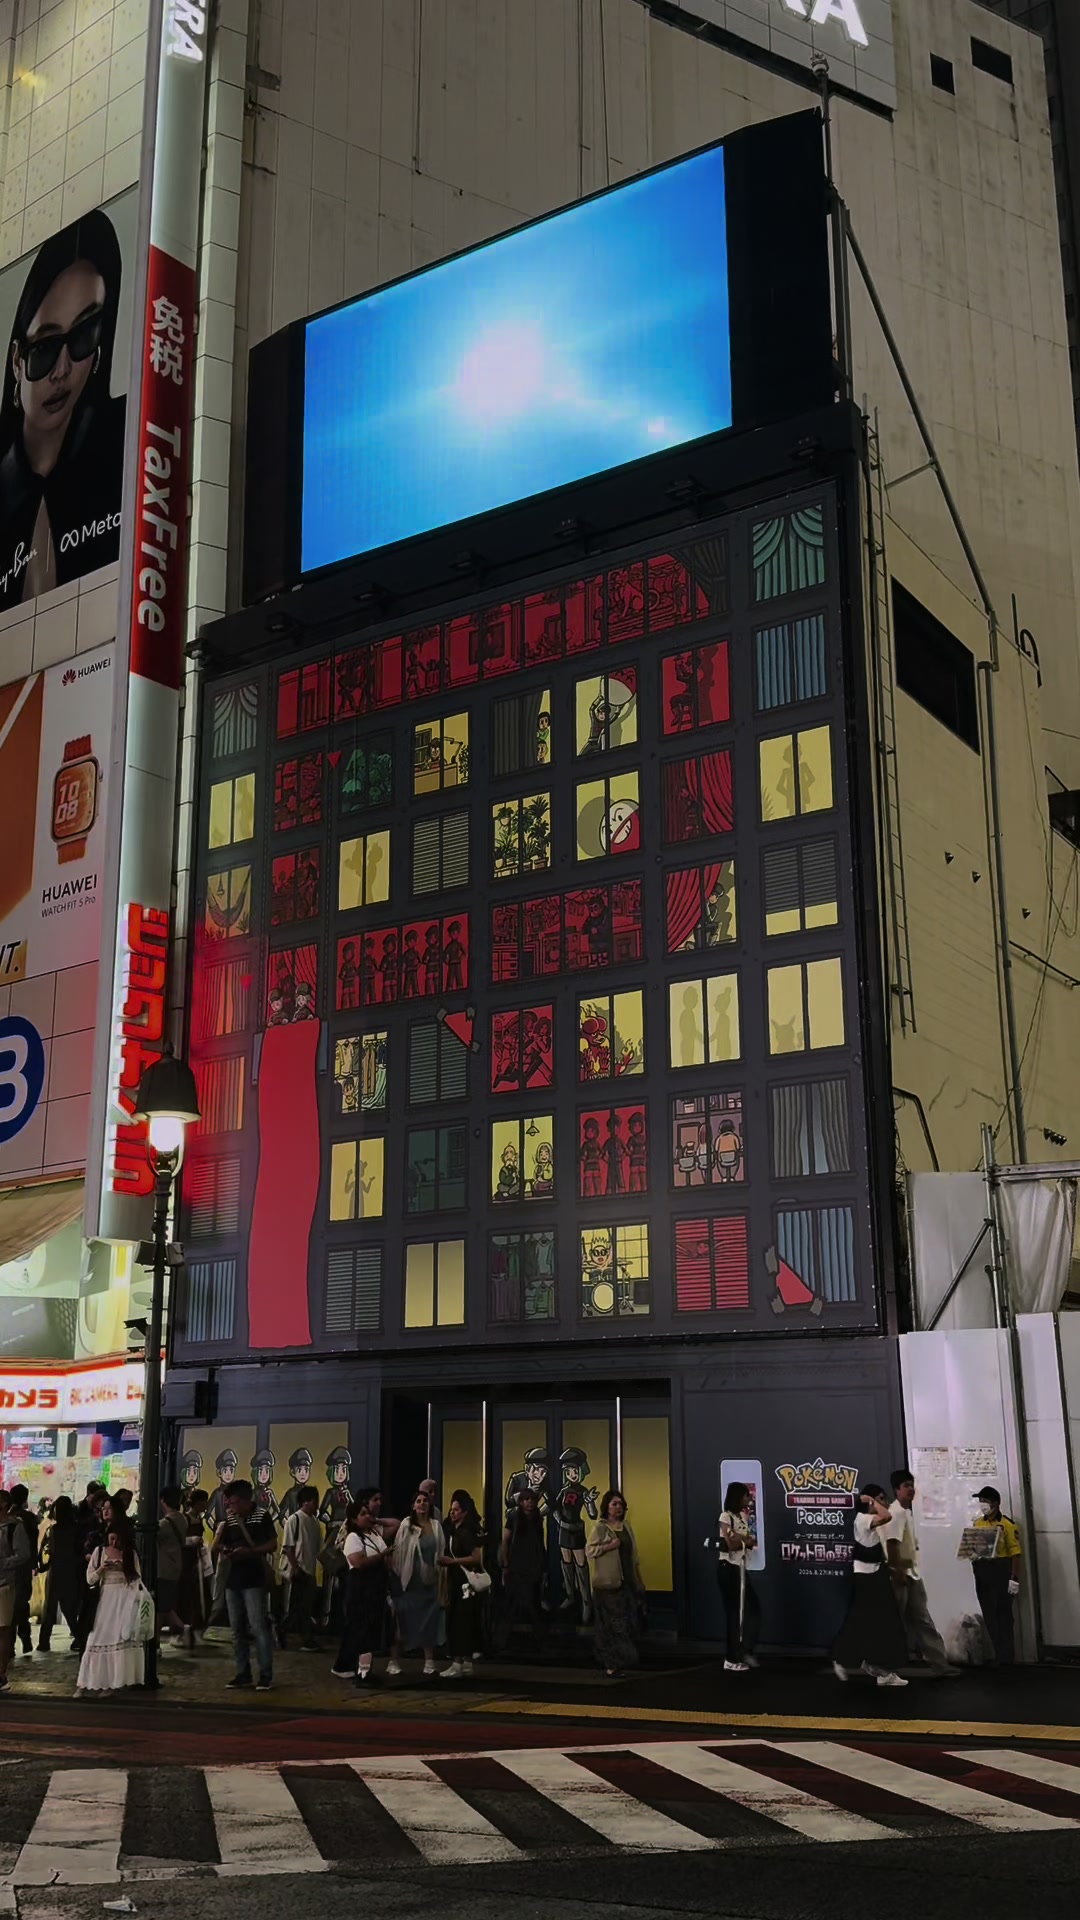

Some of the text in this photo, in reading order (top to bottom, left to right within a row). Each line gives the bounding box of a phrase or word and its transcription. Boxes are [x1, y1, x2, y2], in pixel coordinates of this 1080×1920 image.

[785, 0, 869, 49] A
[149, 295, 186, 386] 免税
[77, 658, 111, 679] HUAWEI
[42, 873, 97, 904] HUAWEI
[41, 902, 67, 918] WATCH
[67, 900, 77, 911] FIT
[796, 1506, 845, 1526] Pocket
